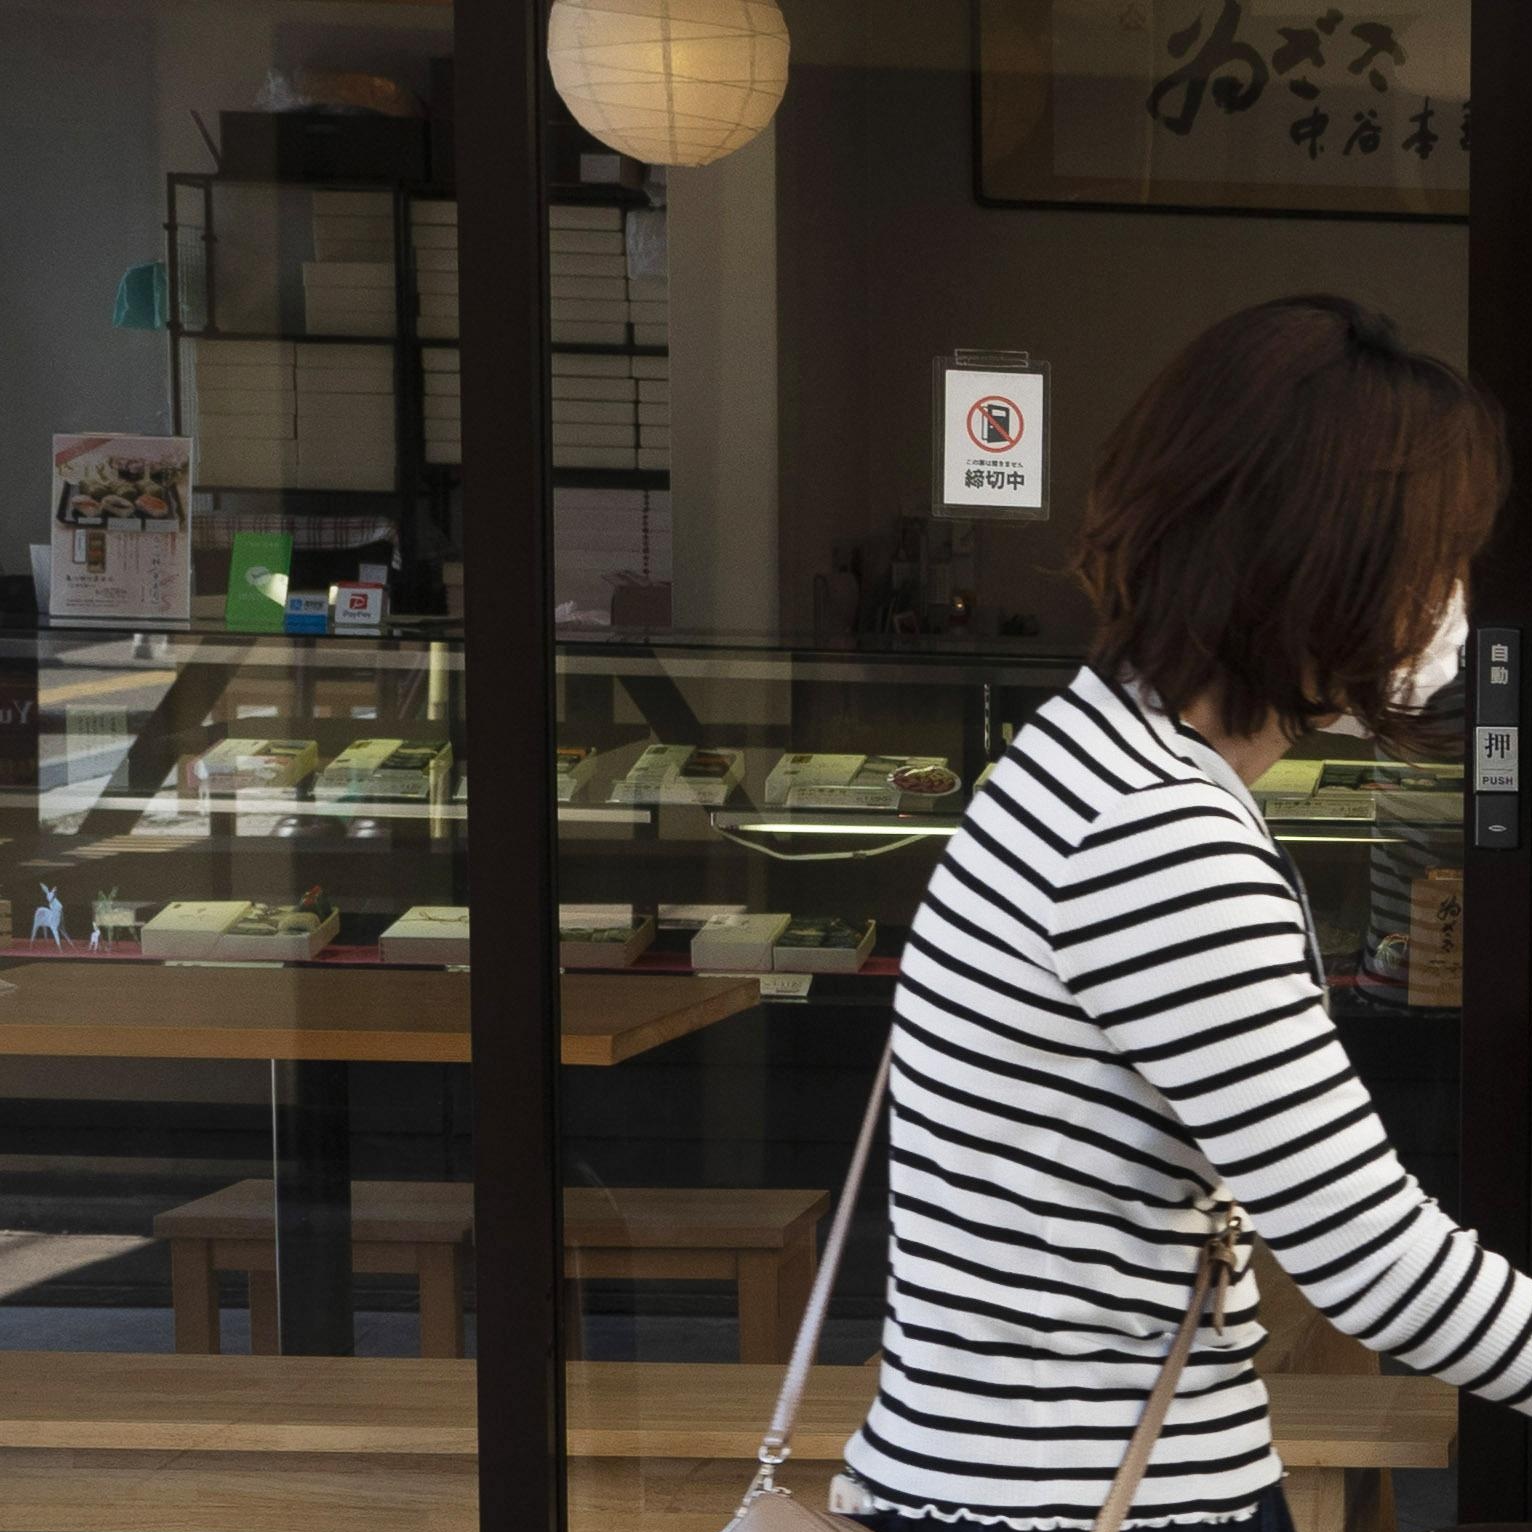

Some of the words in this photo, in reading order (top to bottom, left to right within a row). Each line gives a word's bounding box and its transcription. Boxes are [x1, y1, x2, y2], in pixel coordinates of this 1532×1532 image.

[964, 468, 1025, 491] 締切中
[1490, 643, 1509, 685] 自動
[1484, 731, 1511, 760] 押
[1482, 775, 1513, 786] PUSH
